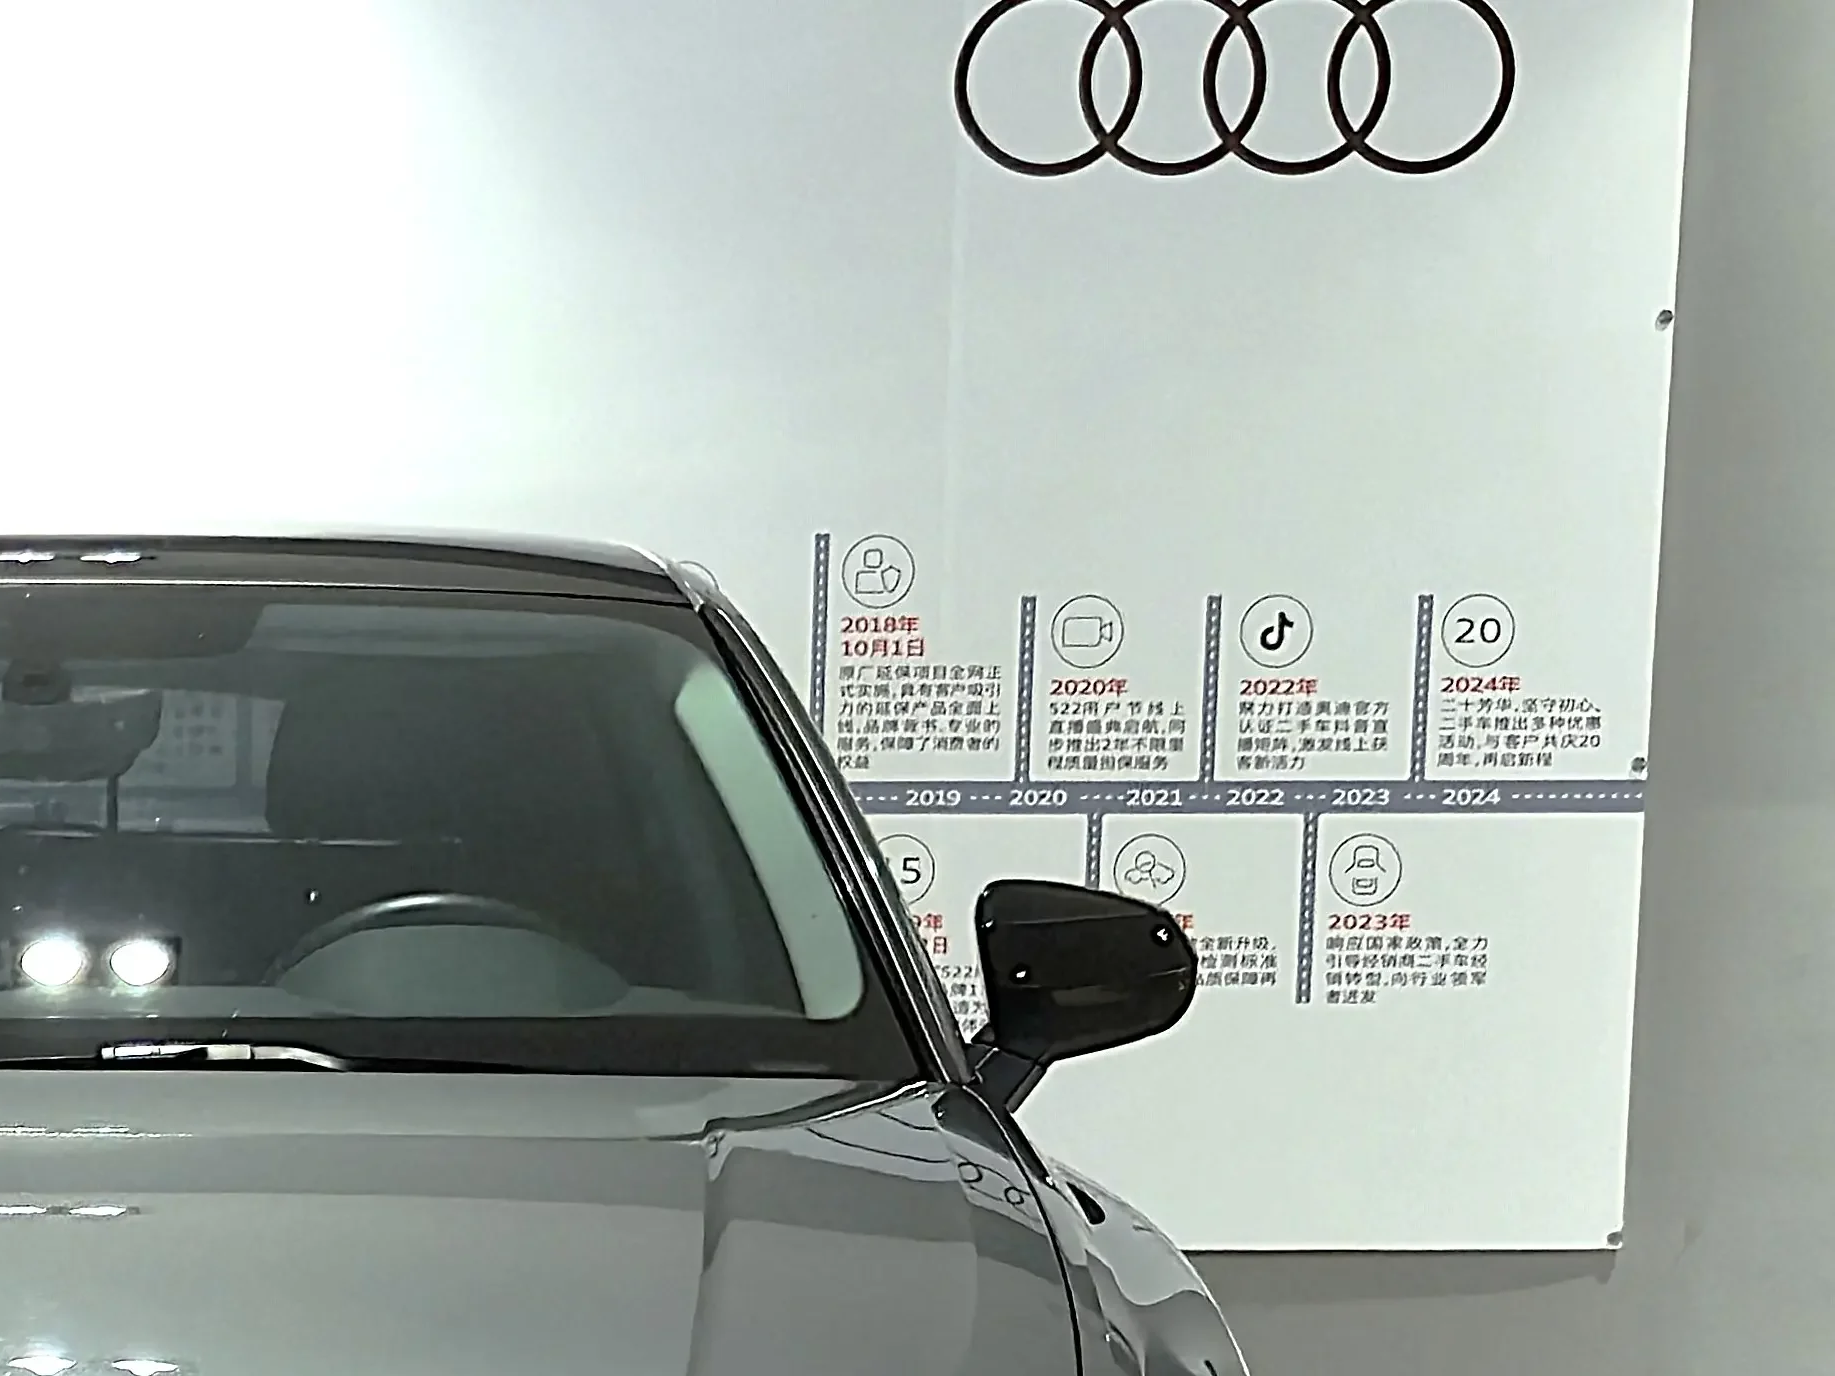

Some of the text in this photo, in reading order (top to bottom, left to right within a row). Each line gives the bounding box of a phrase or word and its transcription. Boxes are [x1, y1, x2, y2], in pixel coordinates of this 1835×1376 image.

[840, 615, 920, 634] 2018年
[1454, 617, 1502, 644] 20
[841, 637, 925, 658] 10月1日
[1049, 678, 1129, 697] 2020年
[1239, 677, 1319, 697] 2022年
[1440, 675, 1521, 694] 2024年
[1049, 700, 1184, 717] 522用户节线上
[1438, 715, 1602, 732] 二手车推出多种优惠
[906, 790, 960, 806] 2019
[1010, 790, 1067, 805] 2020
[1127, 789, 1182, 806] 2021
[1226, 789, 1284, 805] 2022
[1332, 789, 1390, 805] 2023
[1442, 789, 1500, 805] 2024
[1328, 913, 1411, 931] 2023年
